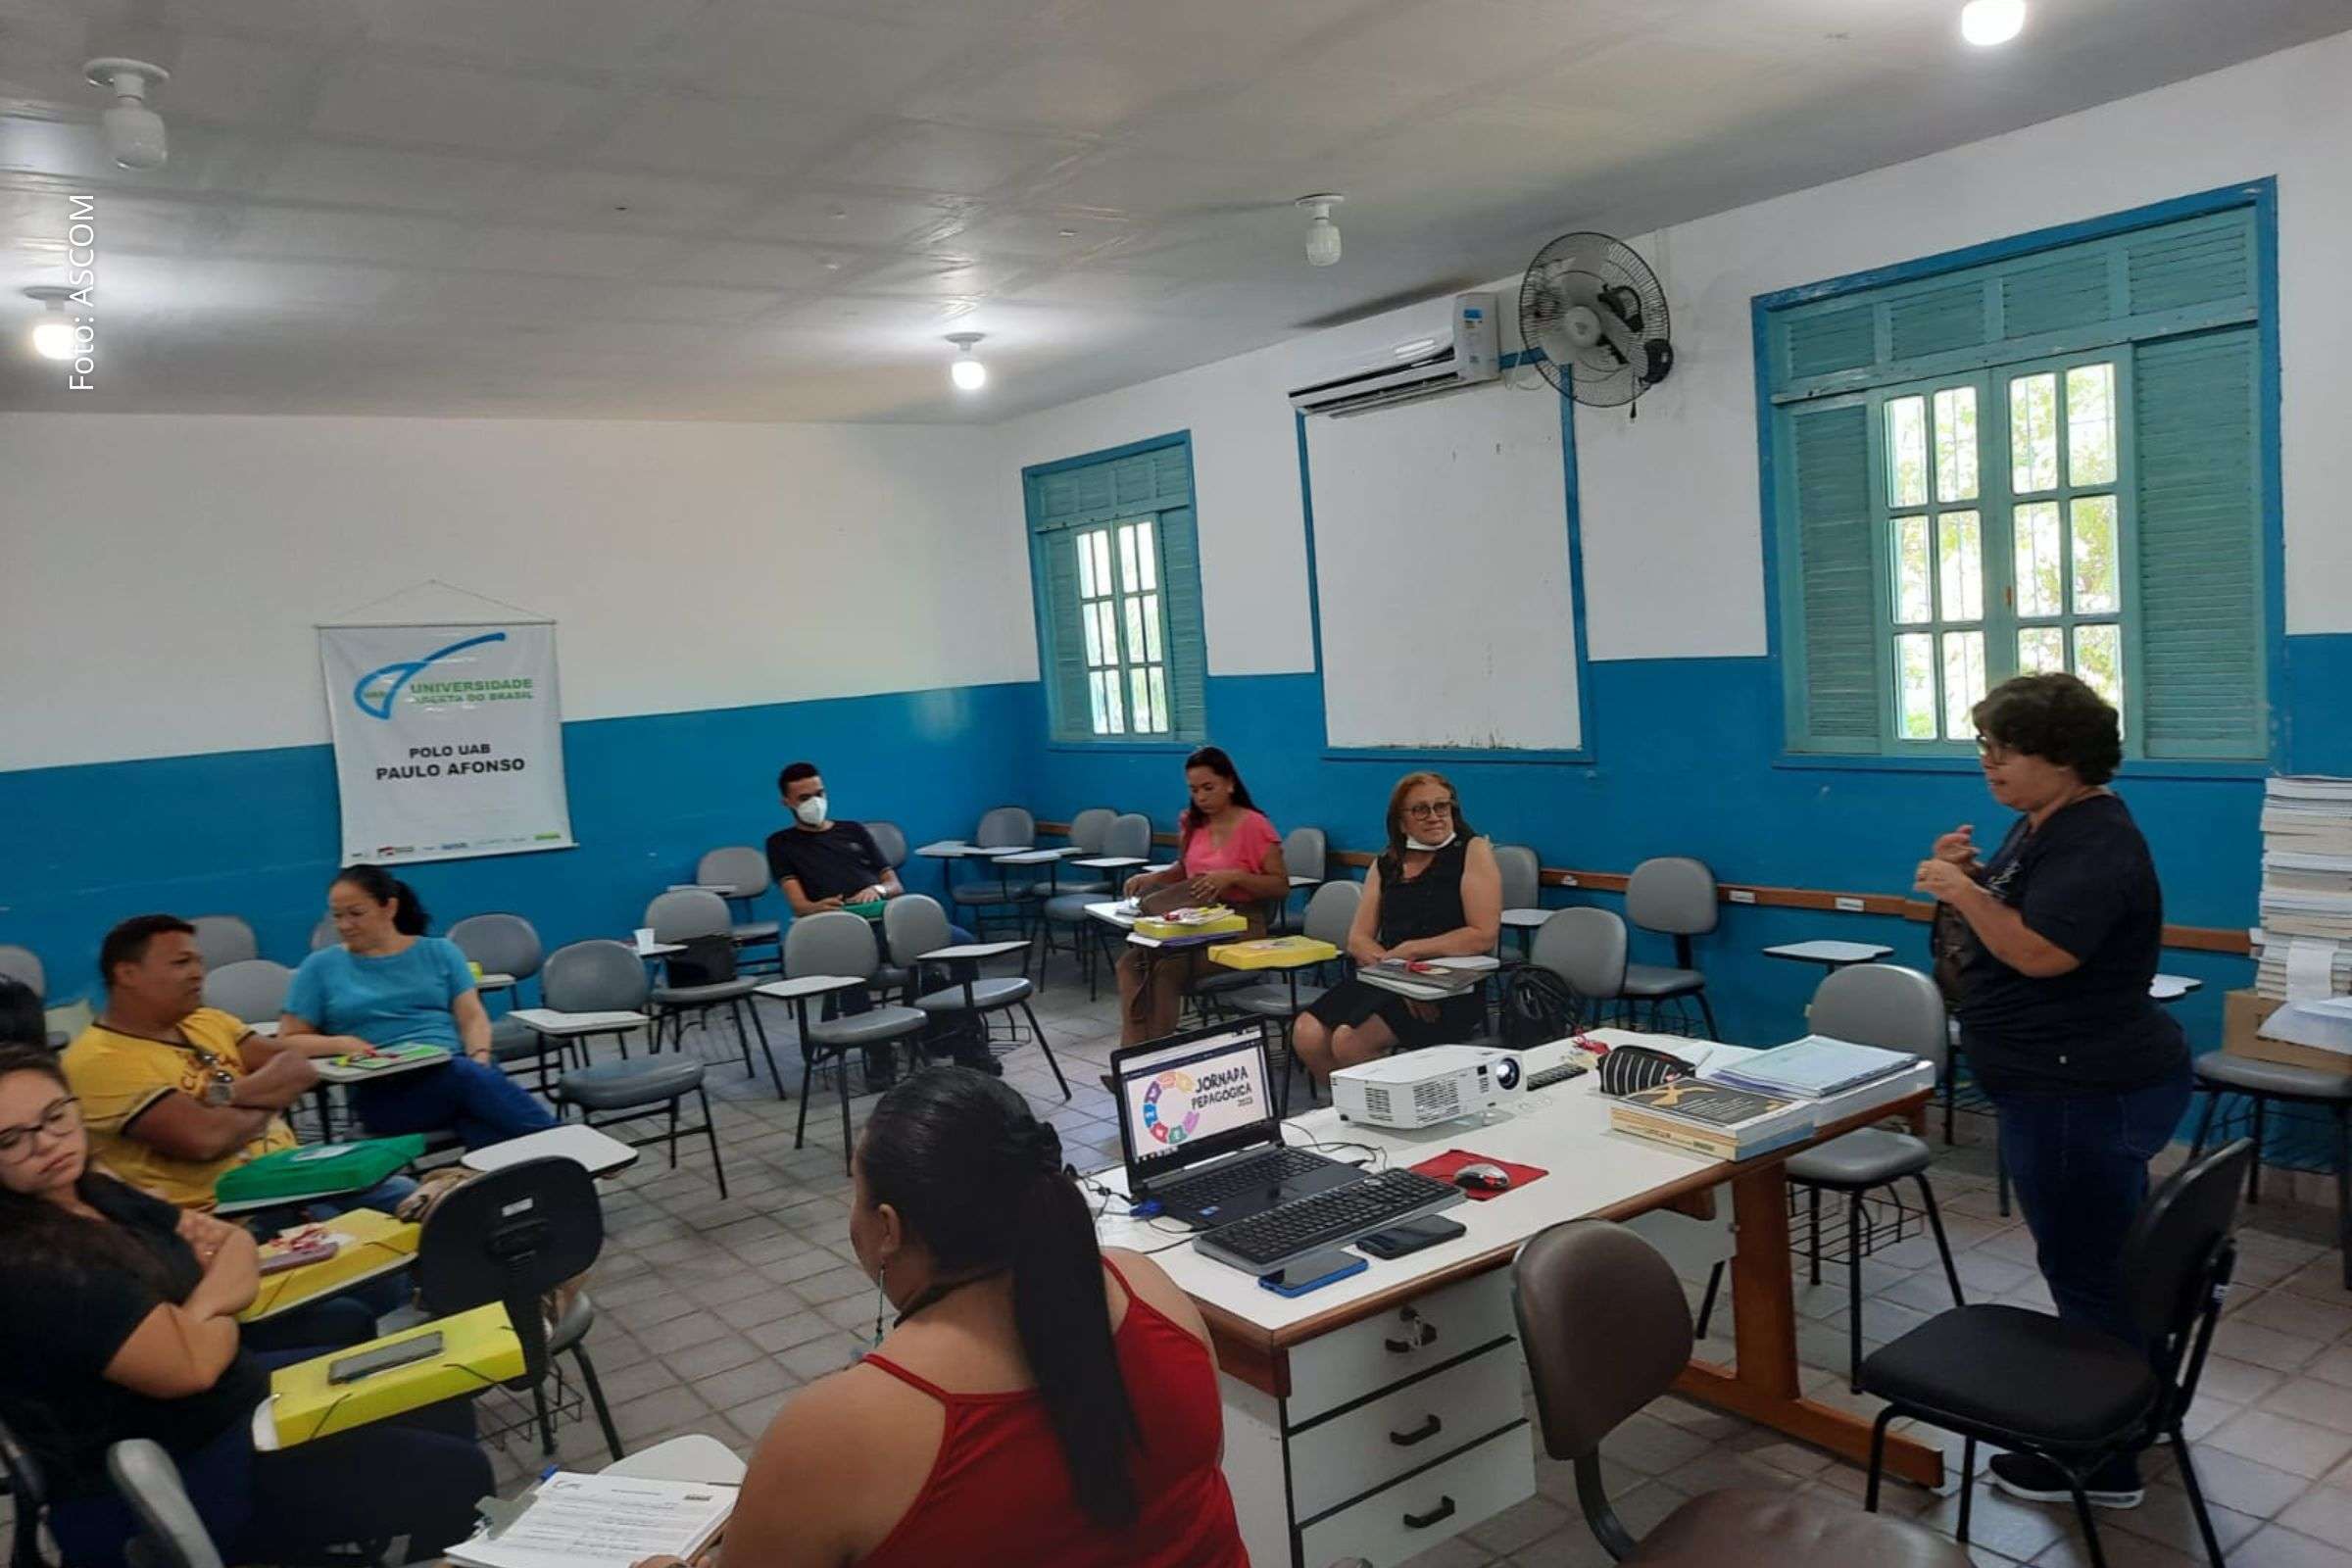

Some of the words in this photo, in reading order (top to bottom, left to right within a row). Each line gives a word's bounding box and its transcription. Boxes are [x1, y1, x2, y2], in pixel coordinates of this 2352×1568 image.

[410, 678, 533, 693] UNIVERSIDADE
[466, 693, 486, 703] DO
[489, 691, 533, 702] BRASIL
[410, 746, 453, 759] POLO
[458, 744, 491, 756] UAB
[376, 764, 441, 780] PAULO
[447, 759, 525, 775] AFONSO
